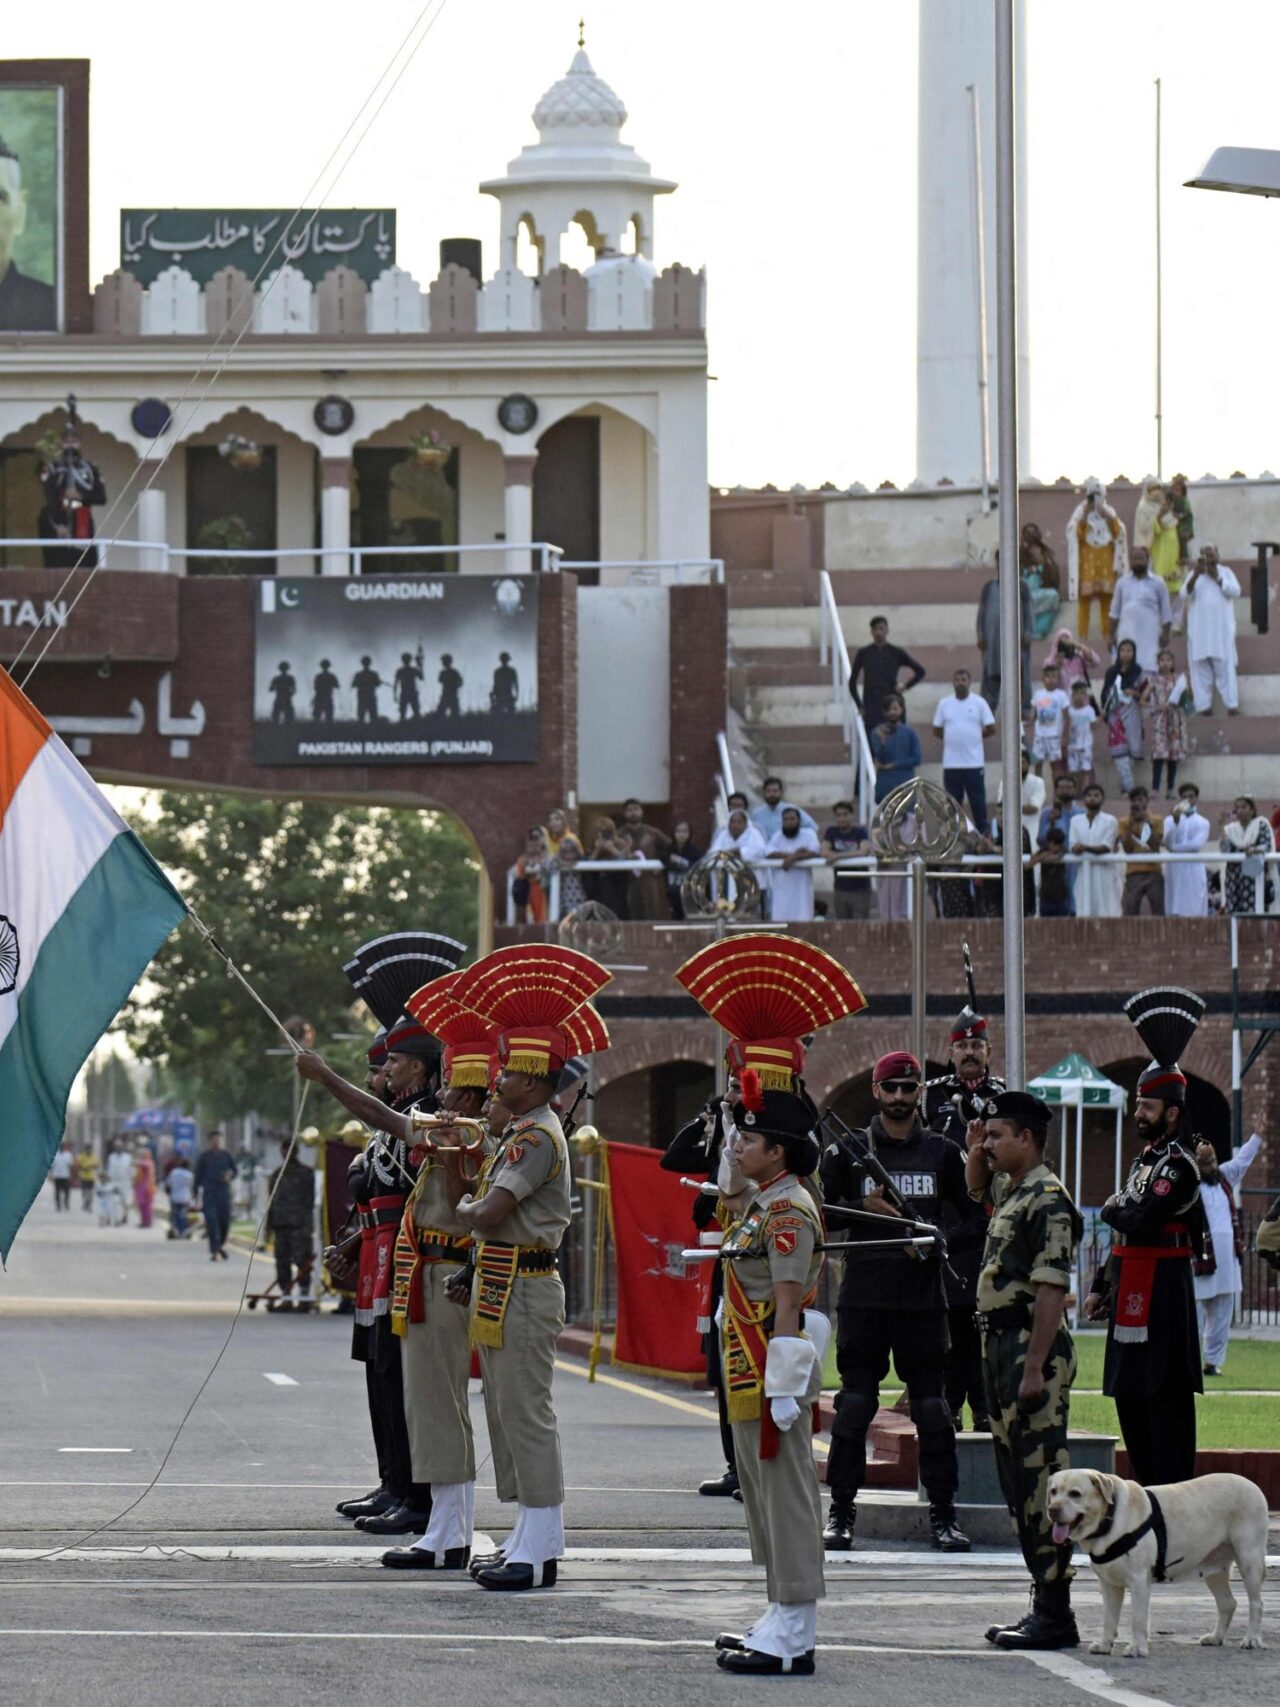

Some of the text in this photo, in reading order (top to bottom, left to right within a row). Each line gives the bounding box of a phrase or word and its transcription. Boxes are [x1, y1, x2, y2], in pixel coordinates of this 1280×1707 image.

[123, 211, 391, 262] پاکستان کا مطلب کیا
[345, 582, 444, 600] GUARDIAN
[298, 740, 493, 757] PAKISTAN RANGERS (PUNJAB)
[864, 1174, 934, 1196] RNGER
